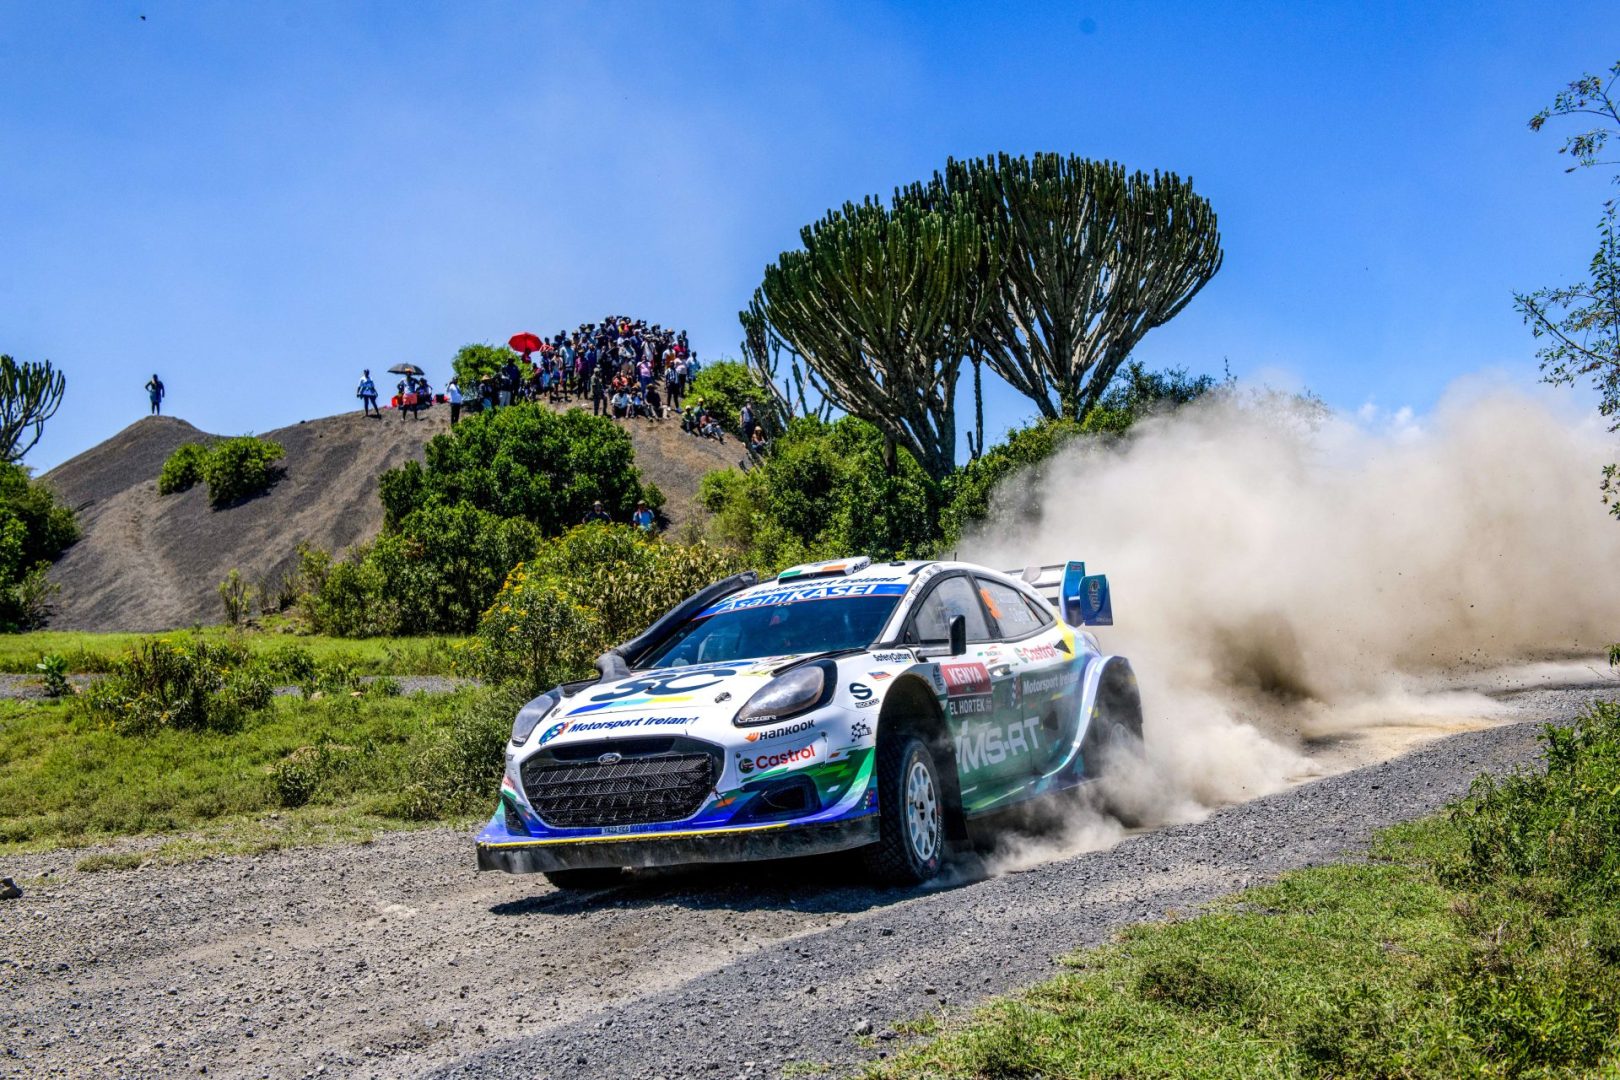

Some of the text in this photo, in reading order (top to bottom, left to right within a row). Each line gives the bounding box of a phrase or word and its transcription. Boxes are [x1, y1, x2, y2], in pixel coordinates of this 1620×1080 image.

[1023, 642, 1058, 661] Castrol
[947, 666, 984, 686] KENYA
[1023, 674, 1059, 695] Motorsport
[949, 701, 959, 716] EL
[959, 698, 985, 715] HORTEK
[567, 717, 645, 734] Motorsport
[755, 744, 816, 769] Castrol
